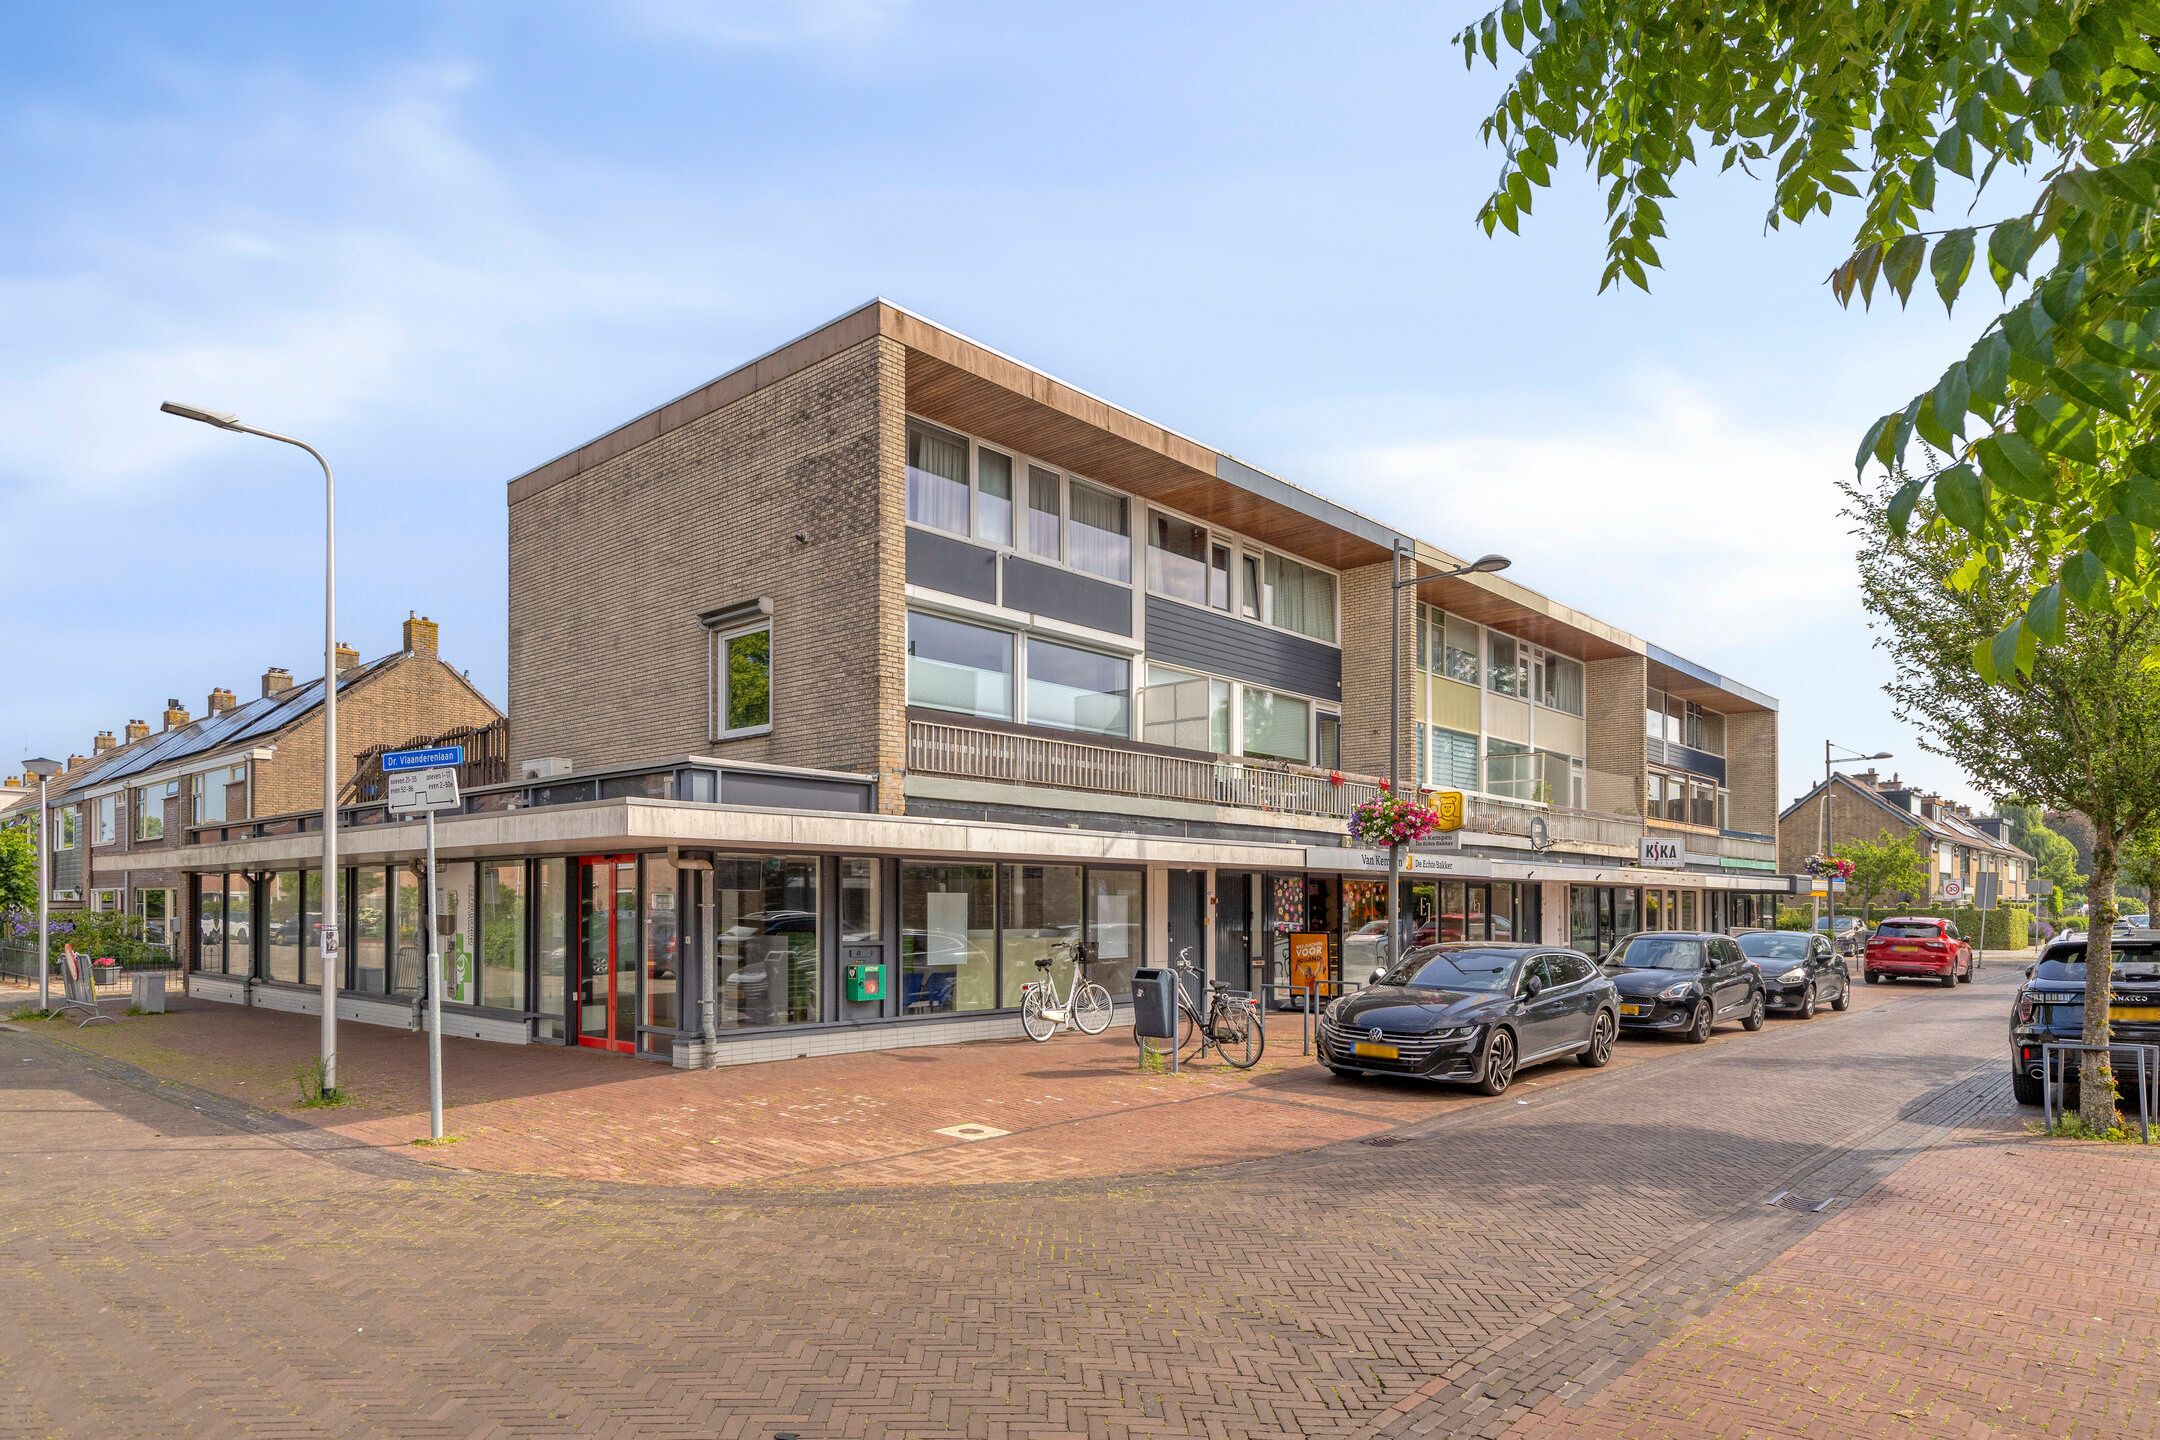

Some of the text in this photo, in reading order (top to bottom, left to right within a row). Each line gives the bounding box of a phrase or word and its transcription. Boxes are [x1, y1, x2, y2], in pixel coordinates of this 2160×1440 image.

[388, 752, 454, 766] Dr. Vlaanderenlaan
[1361, 854, 1403, 866] Van Kemn
[1415, 859, 1453, 870] De Echte Bakker
[1295, 946, 1322, 957] VOOR
